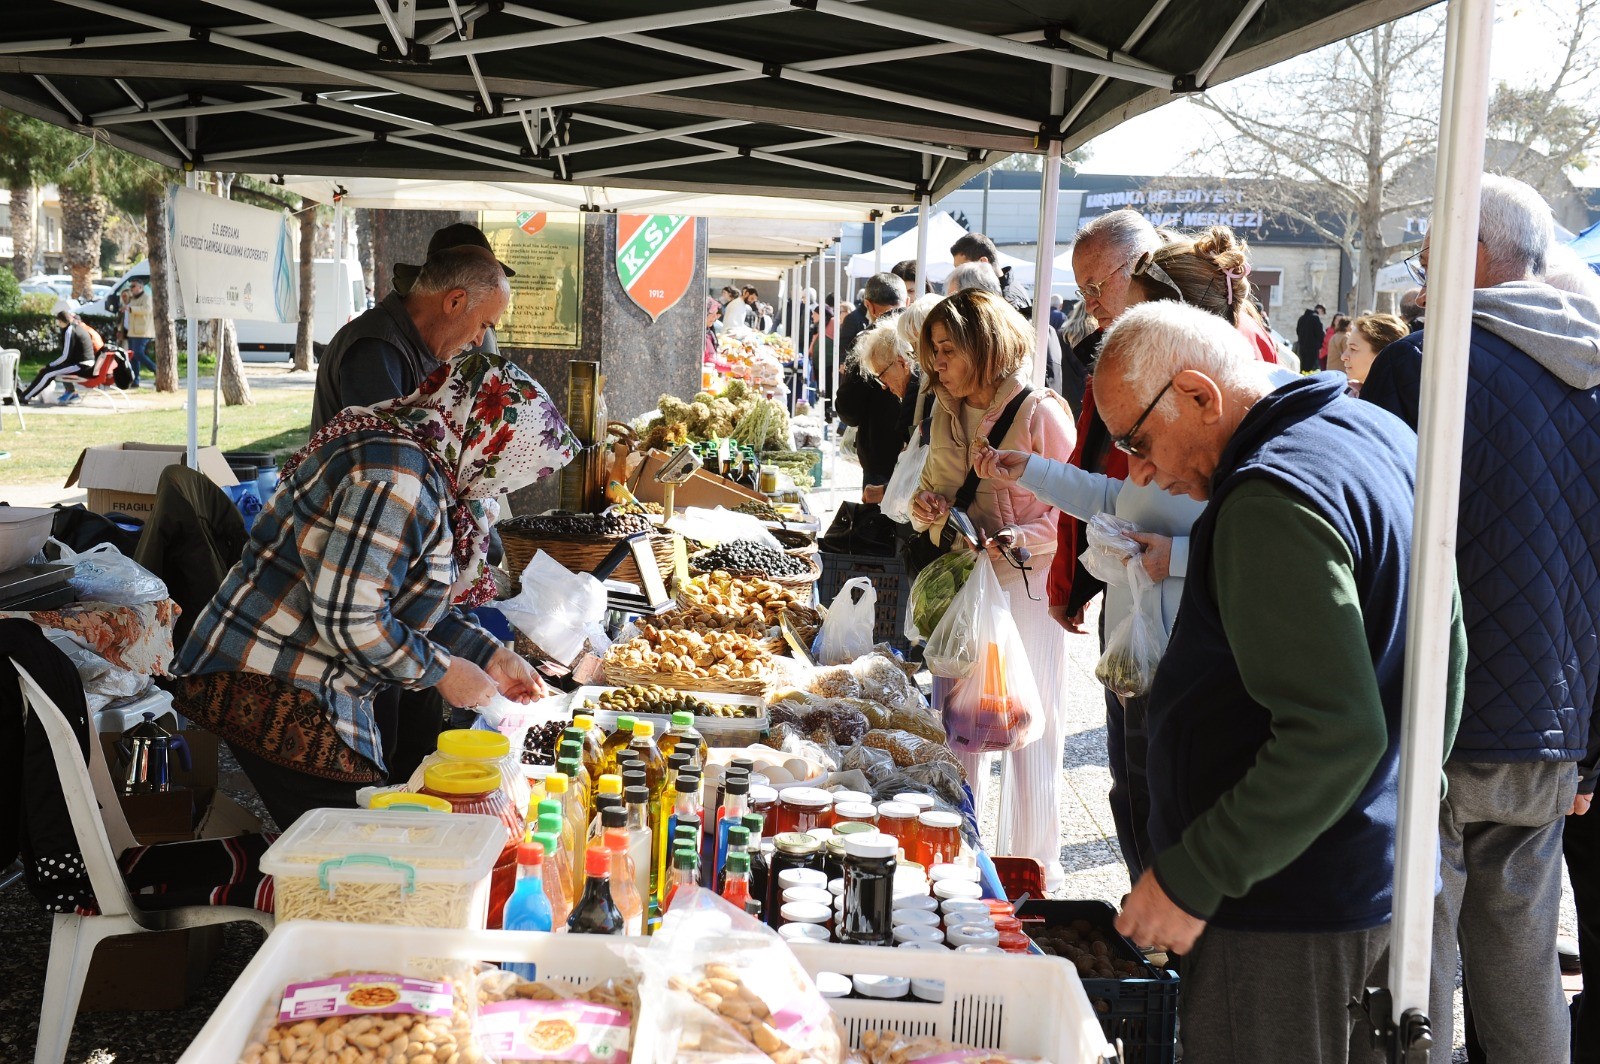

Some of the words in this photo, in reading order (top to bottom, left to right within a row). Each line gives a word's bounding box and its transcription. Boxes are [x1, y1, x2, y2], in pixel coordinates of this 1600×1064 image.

[1086, 191, 1145, 209] KARŞIYAKA
[1183, 209, 1263, 227] MERKEZİ
[220, 225, 240, 240] BERGAMA
[649, 289, 665, 299] 1912
